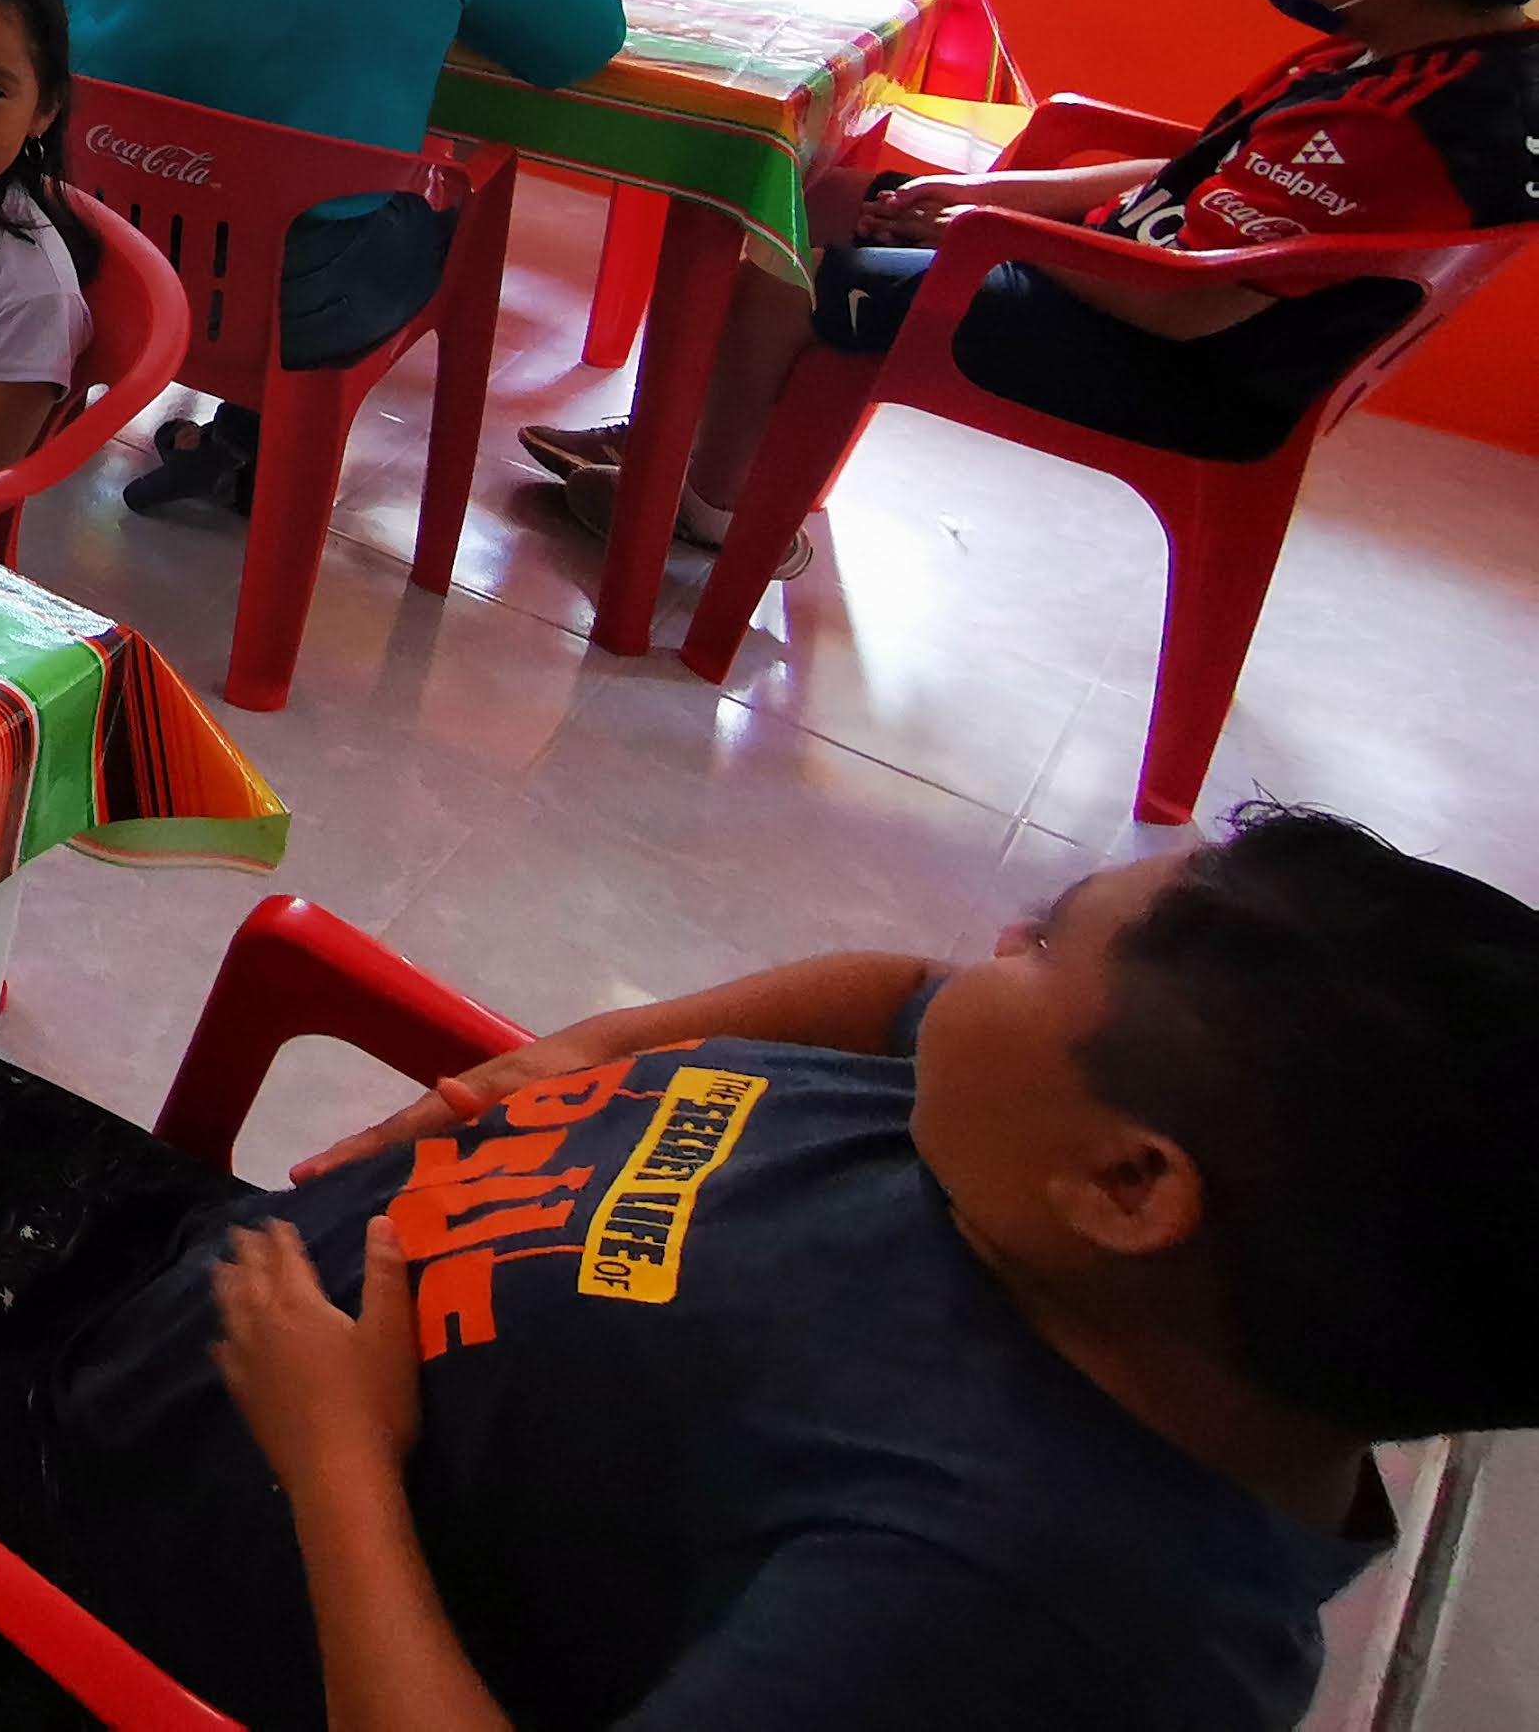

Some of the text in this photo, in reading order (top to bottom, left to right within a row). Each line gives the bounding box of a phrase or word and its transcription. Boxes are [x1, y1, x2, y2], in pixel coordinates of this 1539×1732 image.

[1244, 152, 1358, 218] Totalplay
[706, 1076, 754, 1104] THE
[597, 1192, 681, 1266] LIFE
[593, 1260, 632, 1292] OF
